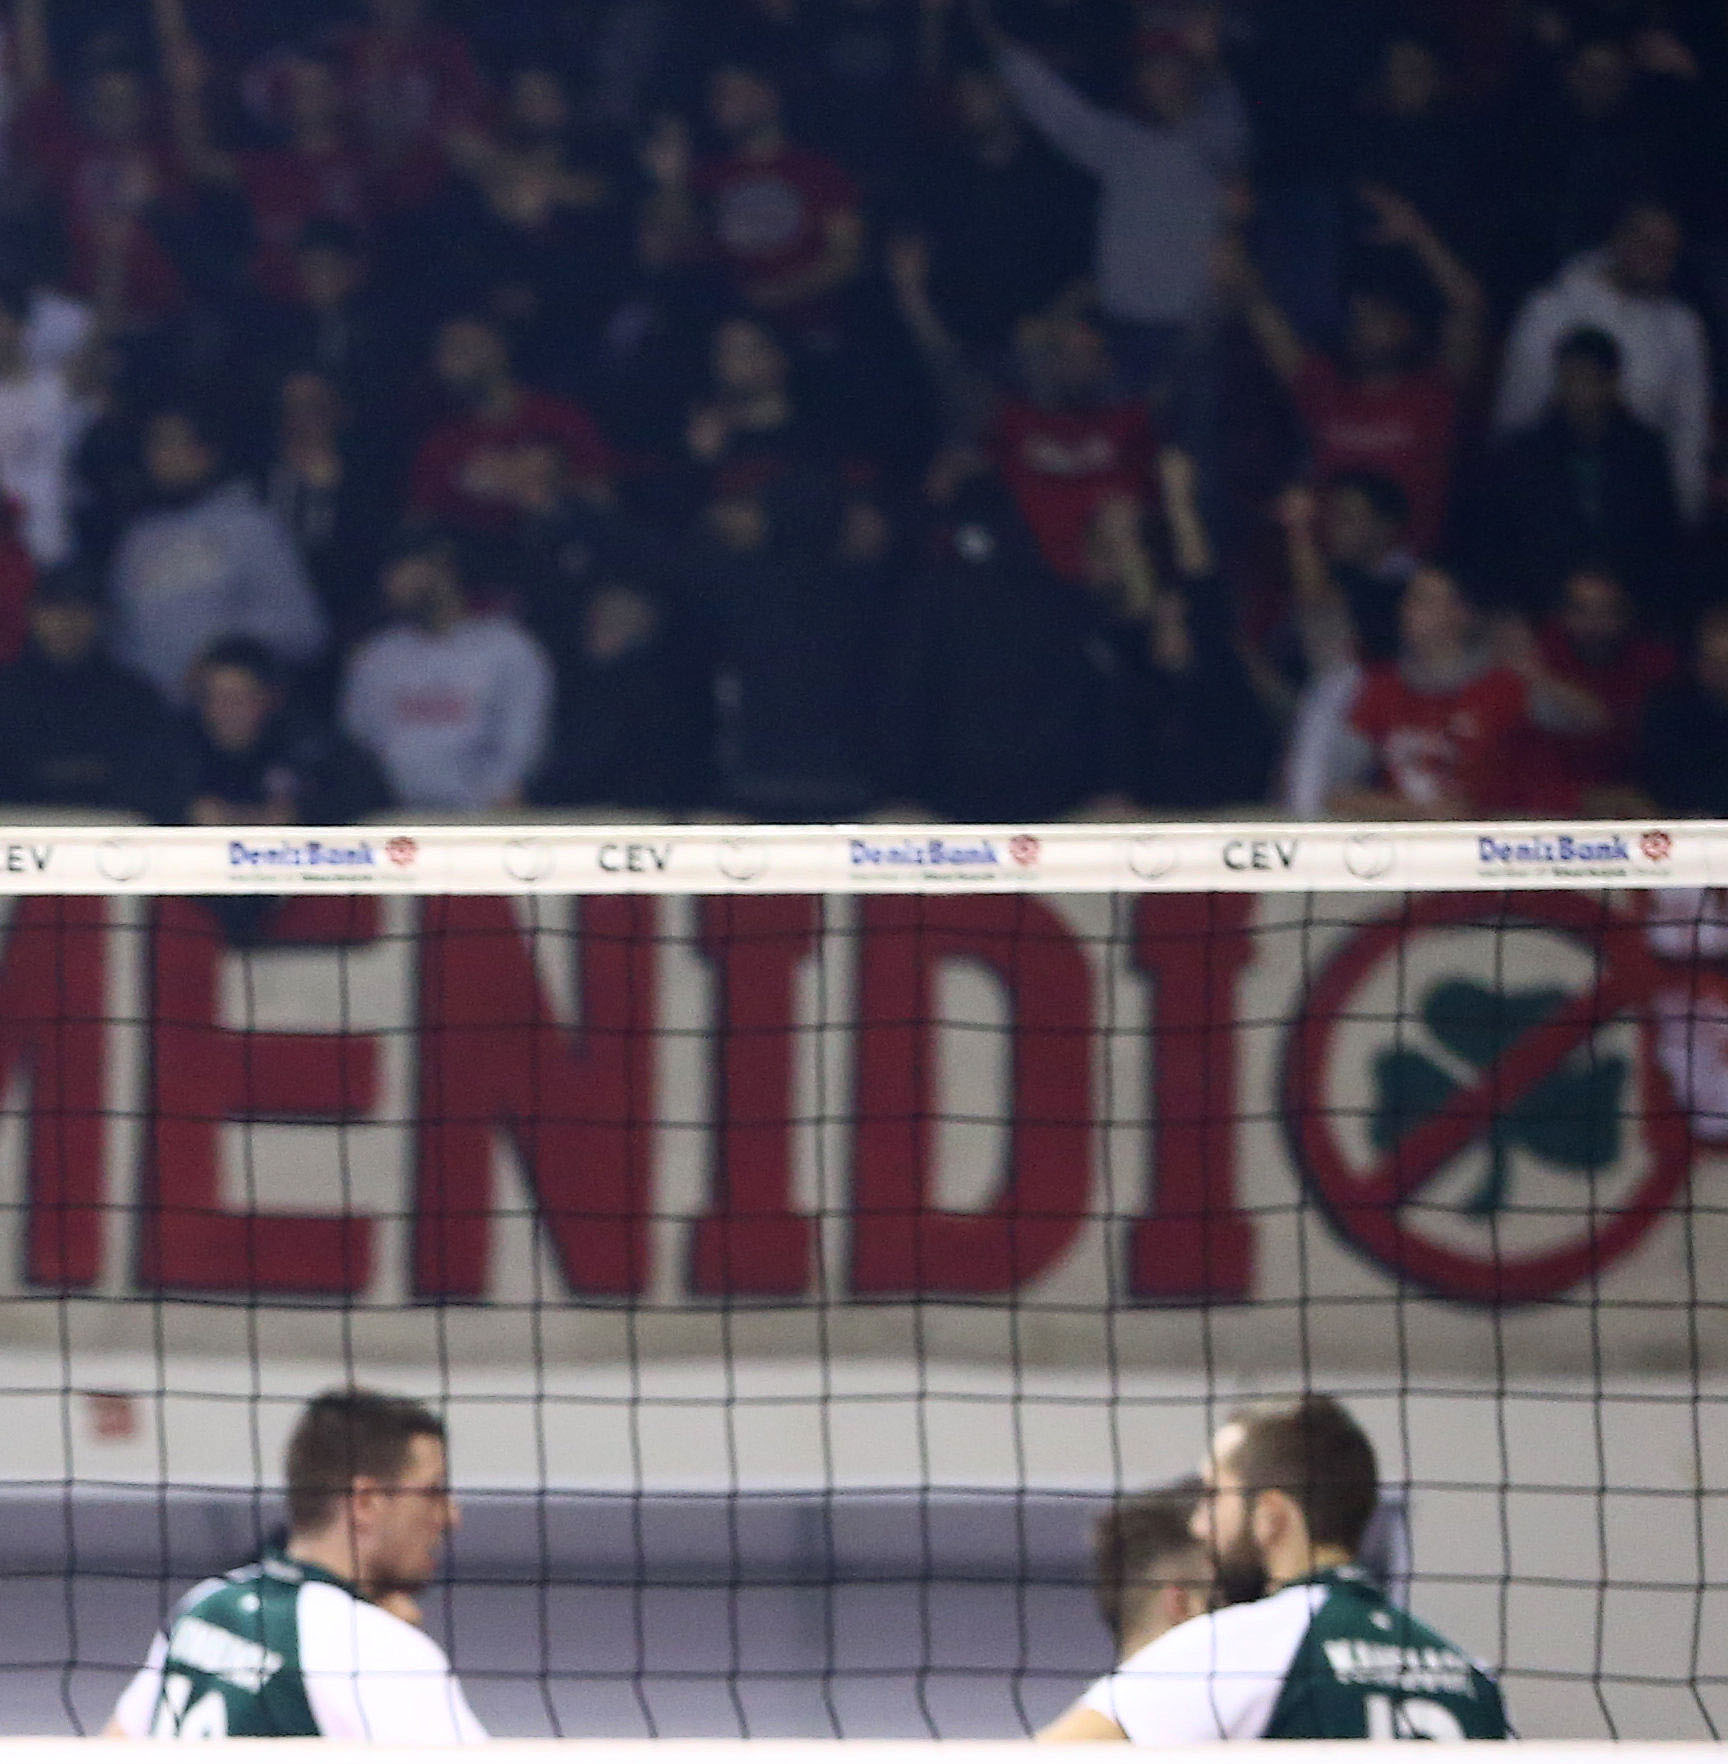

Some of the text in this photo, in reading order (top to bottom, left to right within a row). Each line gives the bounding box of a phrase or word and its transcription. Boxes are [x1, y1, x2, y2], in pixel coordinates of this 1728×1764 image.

[229, 840, 374, 867] DenizBank
[597, 845, 671, 873] CEV
[850, 839, 999, 867] DenizBank
[1221, 842, 1299, 871] CEV
[1479, 836, 1629, 863] DenizBank
